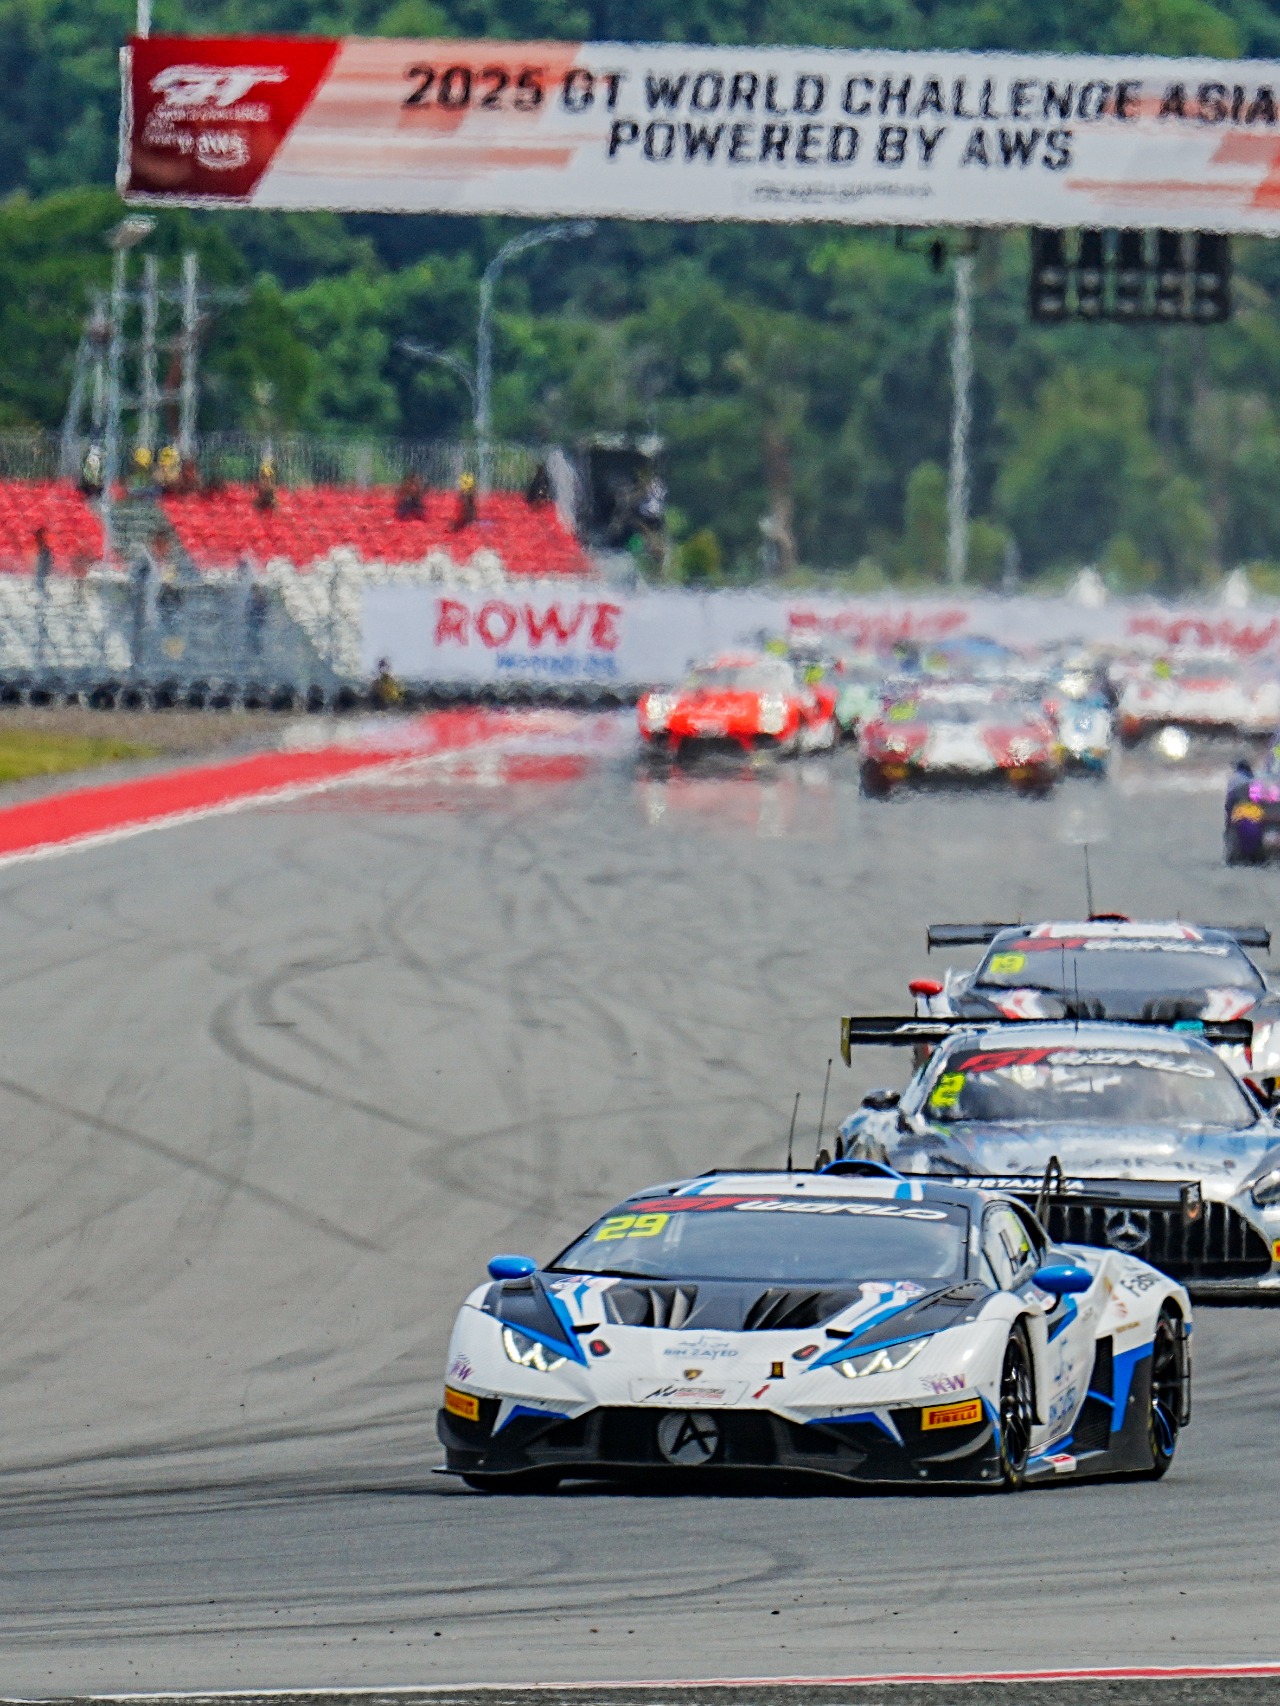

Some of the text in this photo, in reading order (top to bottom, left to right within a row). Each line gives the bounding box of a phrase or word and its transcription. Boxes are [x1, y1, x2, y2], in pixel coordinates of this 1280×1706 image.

[404, 65, 1280, 127] 2025 GT WORLD CHALLENGE ASIA
[607, 119, 1074, 171] POWERED BY AWS
[434, 599, 622, 651] ROWE
[930, 1072, 966, 1108] 2
[628, 1196, 948, 1221] GT WORLD
[594, 1213, 670, 1242] 29
[929, 1404, 977, 1425] PIRELLI
